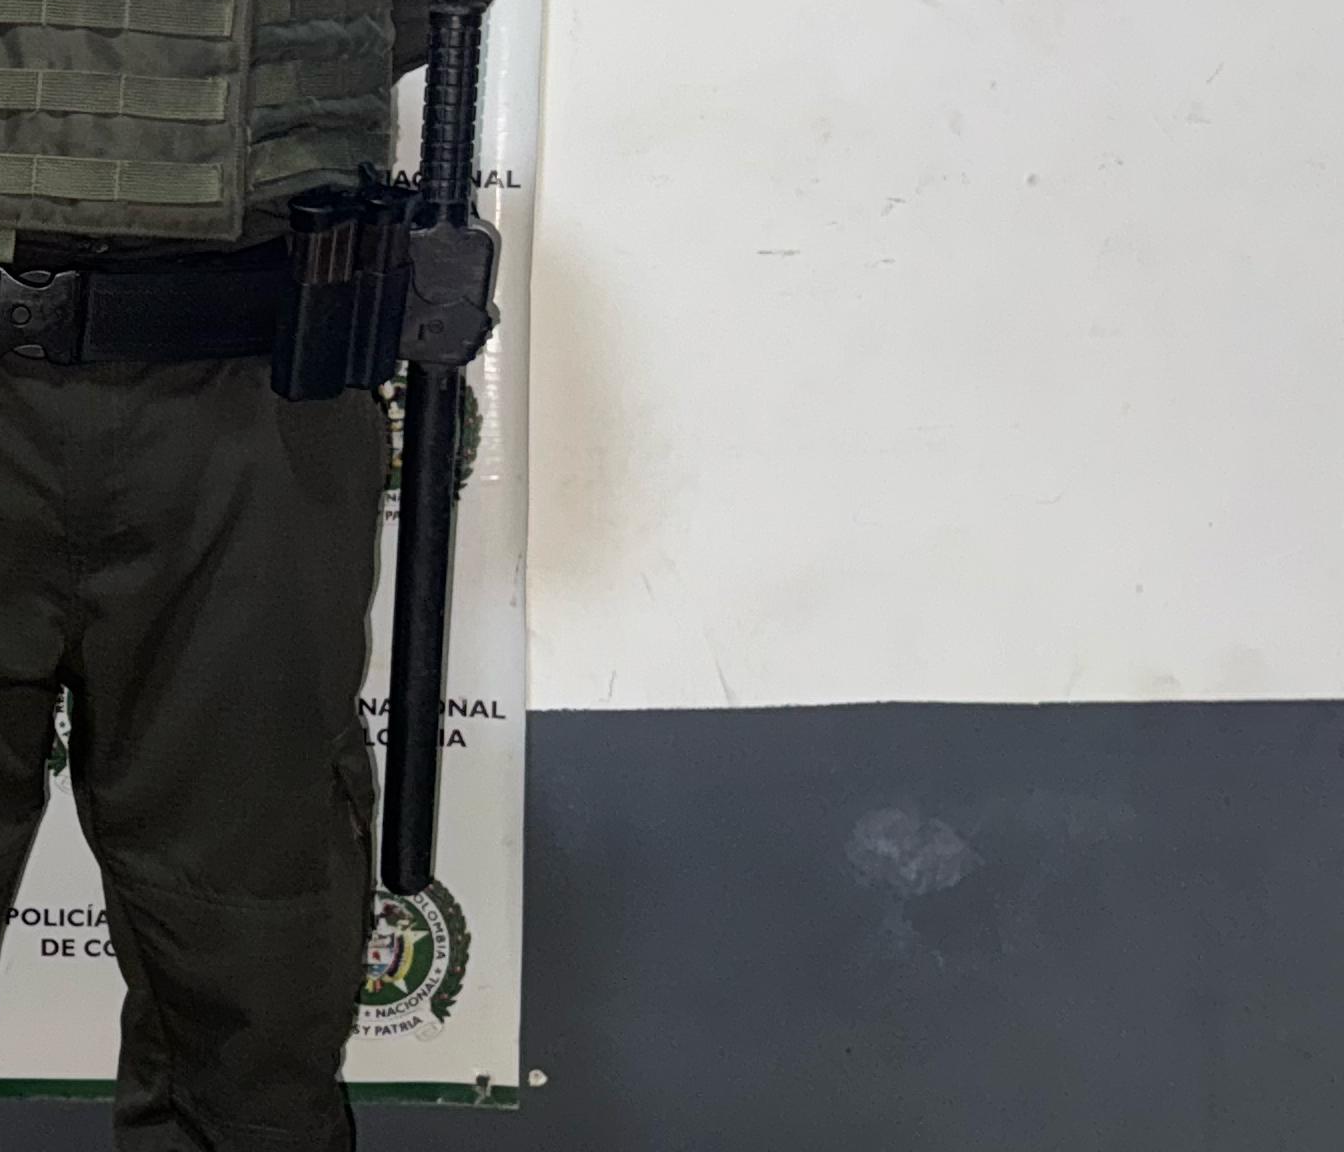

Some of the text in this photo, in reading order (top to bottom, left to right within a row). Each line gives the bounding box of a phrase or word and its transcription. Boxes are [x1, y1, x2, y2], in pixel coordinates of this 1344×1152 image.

[5, 904, 109, 927] POLICÍA
[41, 938, 76, 957] DE
[376, 974, 441, 1018] NACIONAL
[375, 1016, 424, 1036] PATRIA
